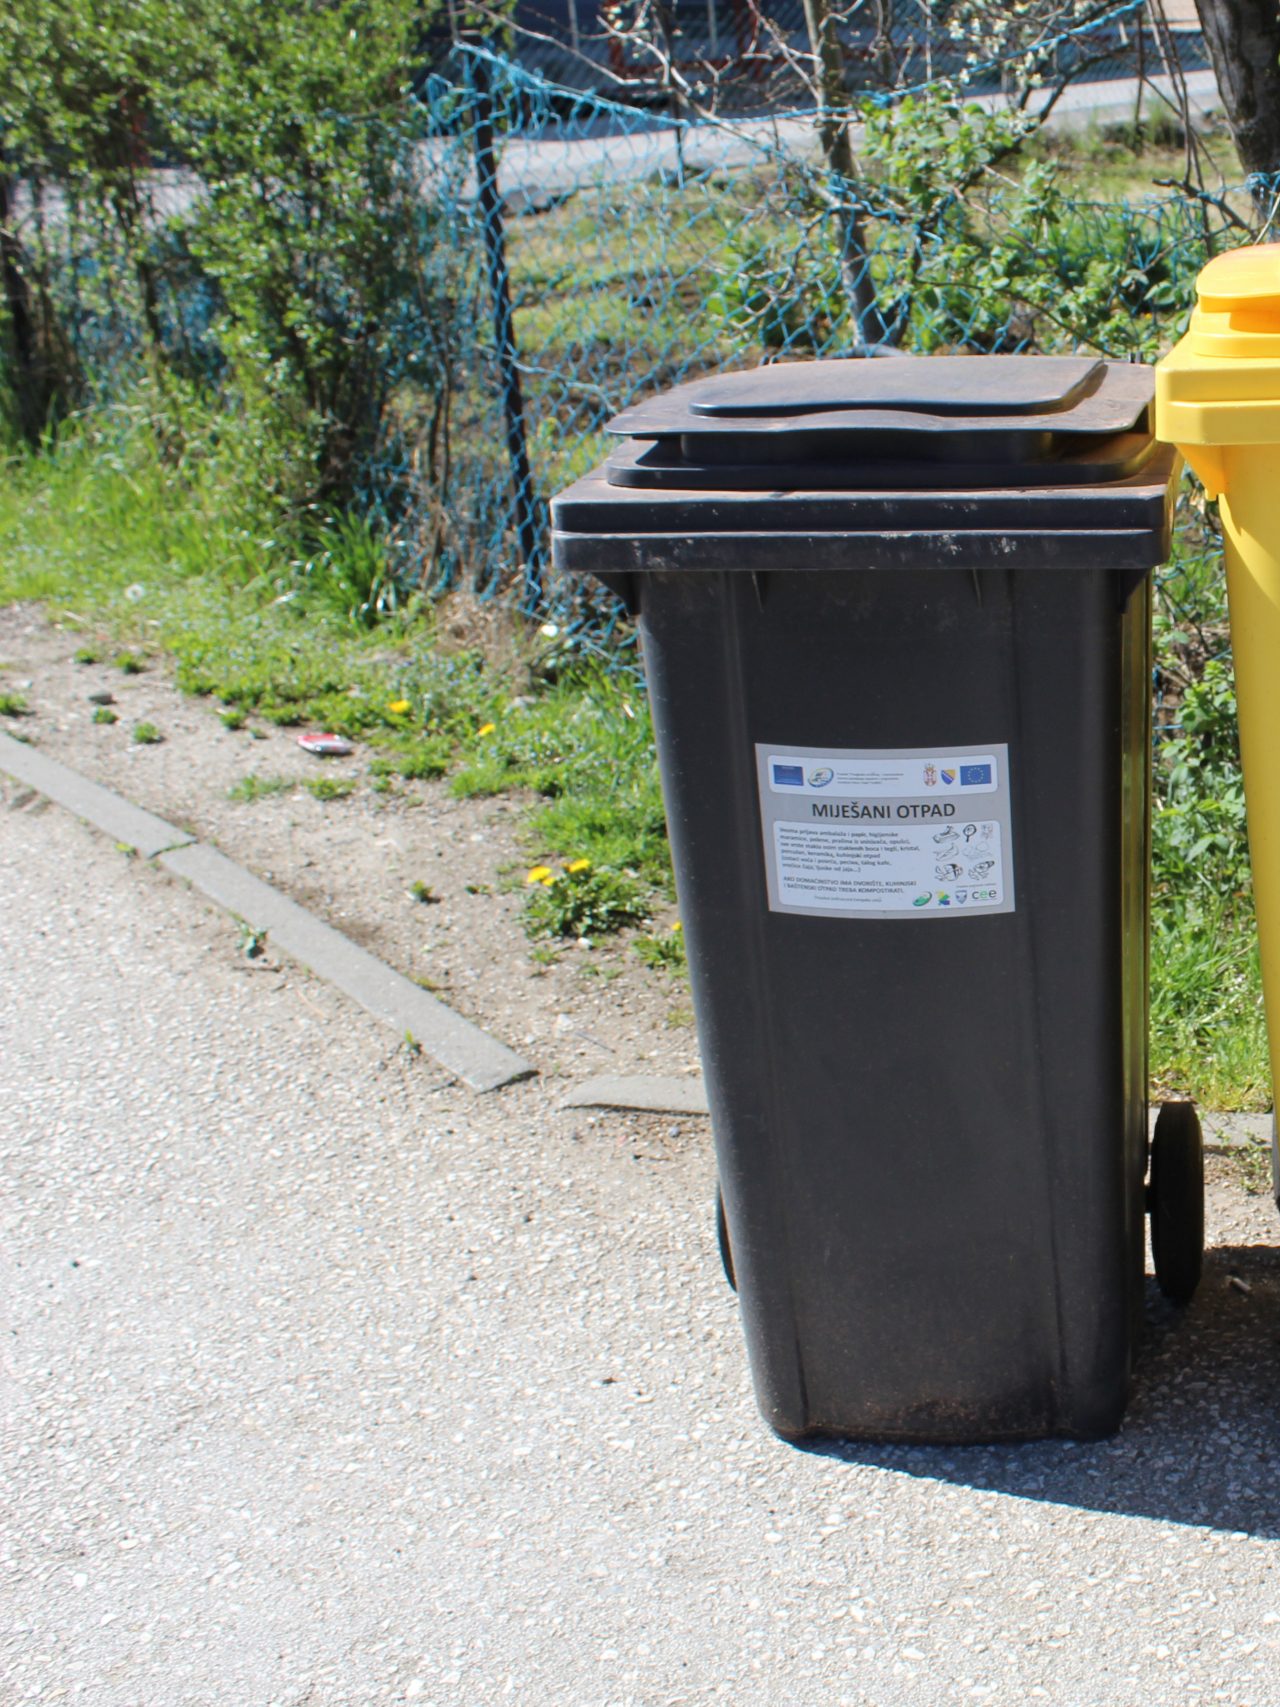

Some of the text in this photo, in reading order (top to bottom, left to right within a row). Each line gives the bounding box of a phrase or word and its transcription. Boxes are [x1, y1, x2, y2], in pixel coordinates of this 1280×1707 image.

[812, 802, 956, 818] MIJEŠANI OTPAD
[972, 890, 997, 899] cee
